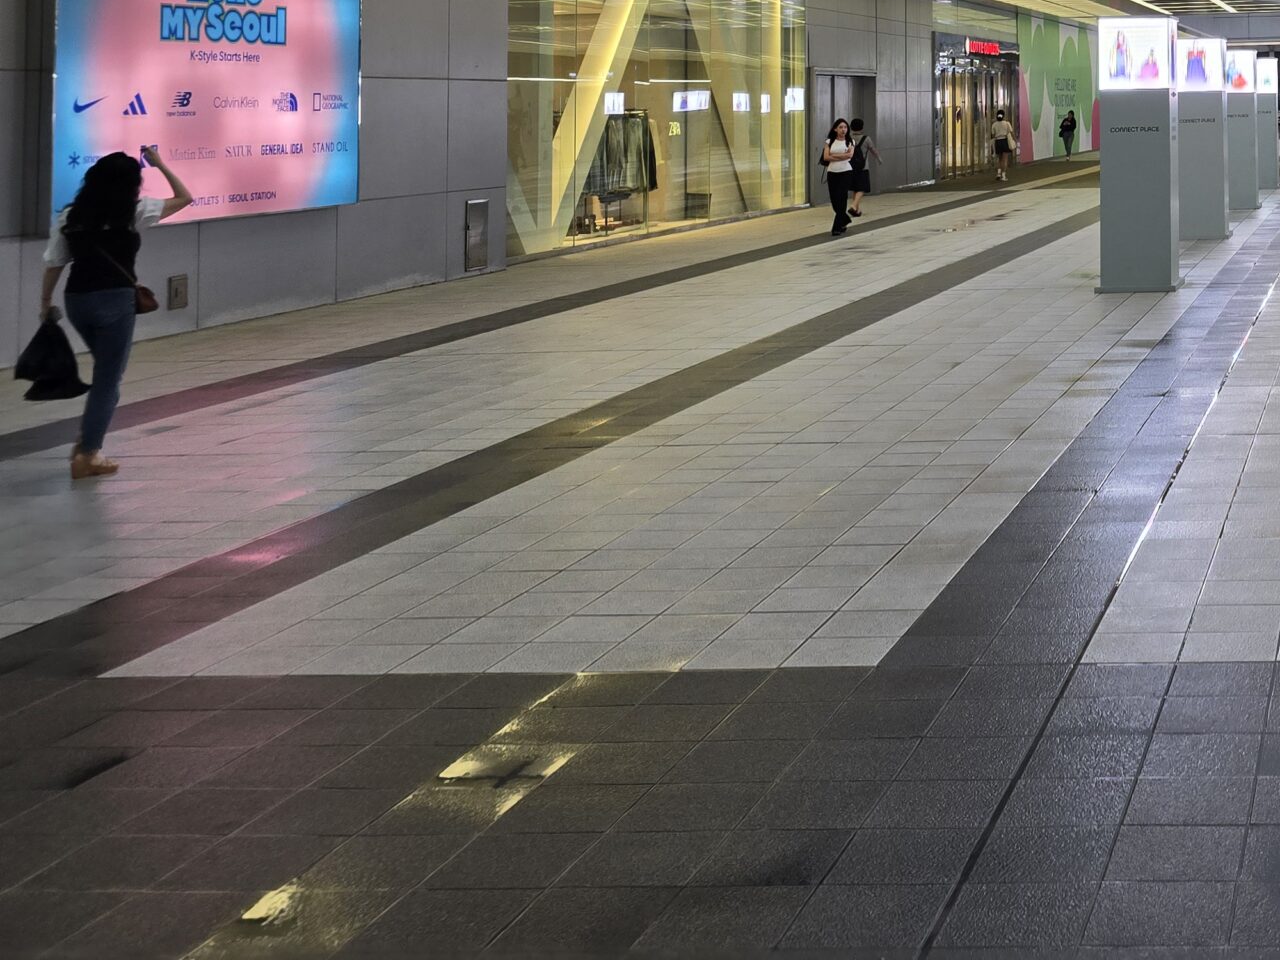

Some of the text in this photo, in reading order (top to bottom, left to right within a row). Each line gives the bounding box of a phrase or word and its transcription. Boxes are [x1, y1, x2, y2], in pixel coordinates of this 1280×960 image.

[190, 50, 260, 63] K-Style Starts Here
[261, 143, 303, 155] GENERAL IDEA
[312, 141, 348, 154] STAND OIL
[228, 192, 248, 203] SEOUL
[250, 191, 276, 201] STATION
